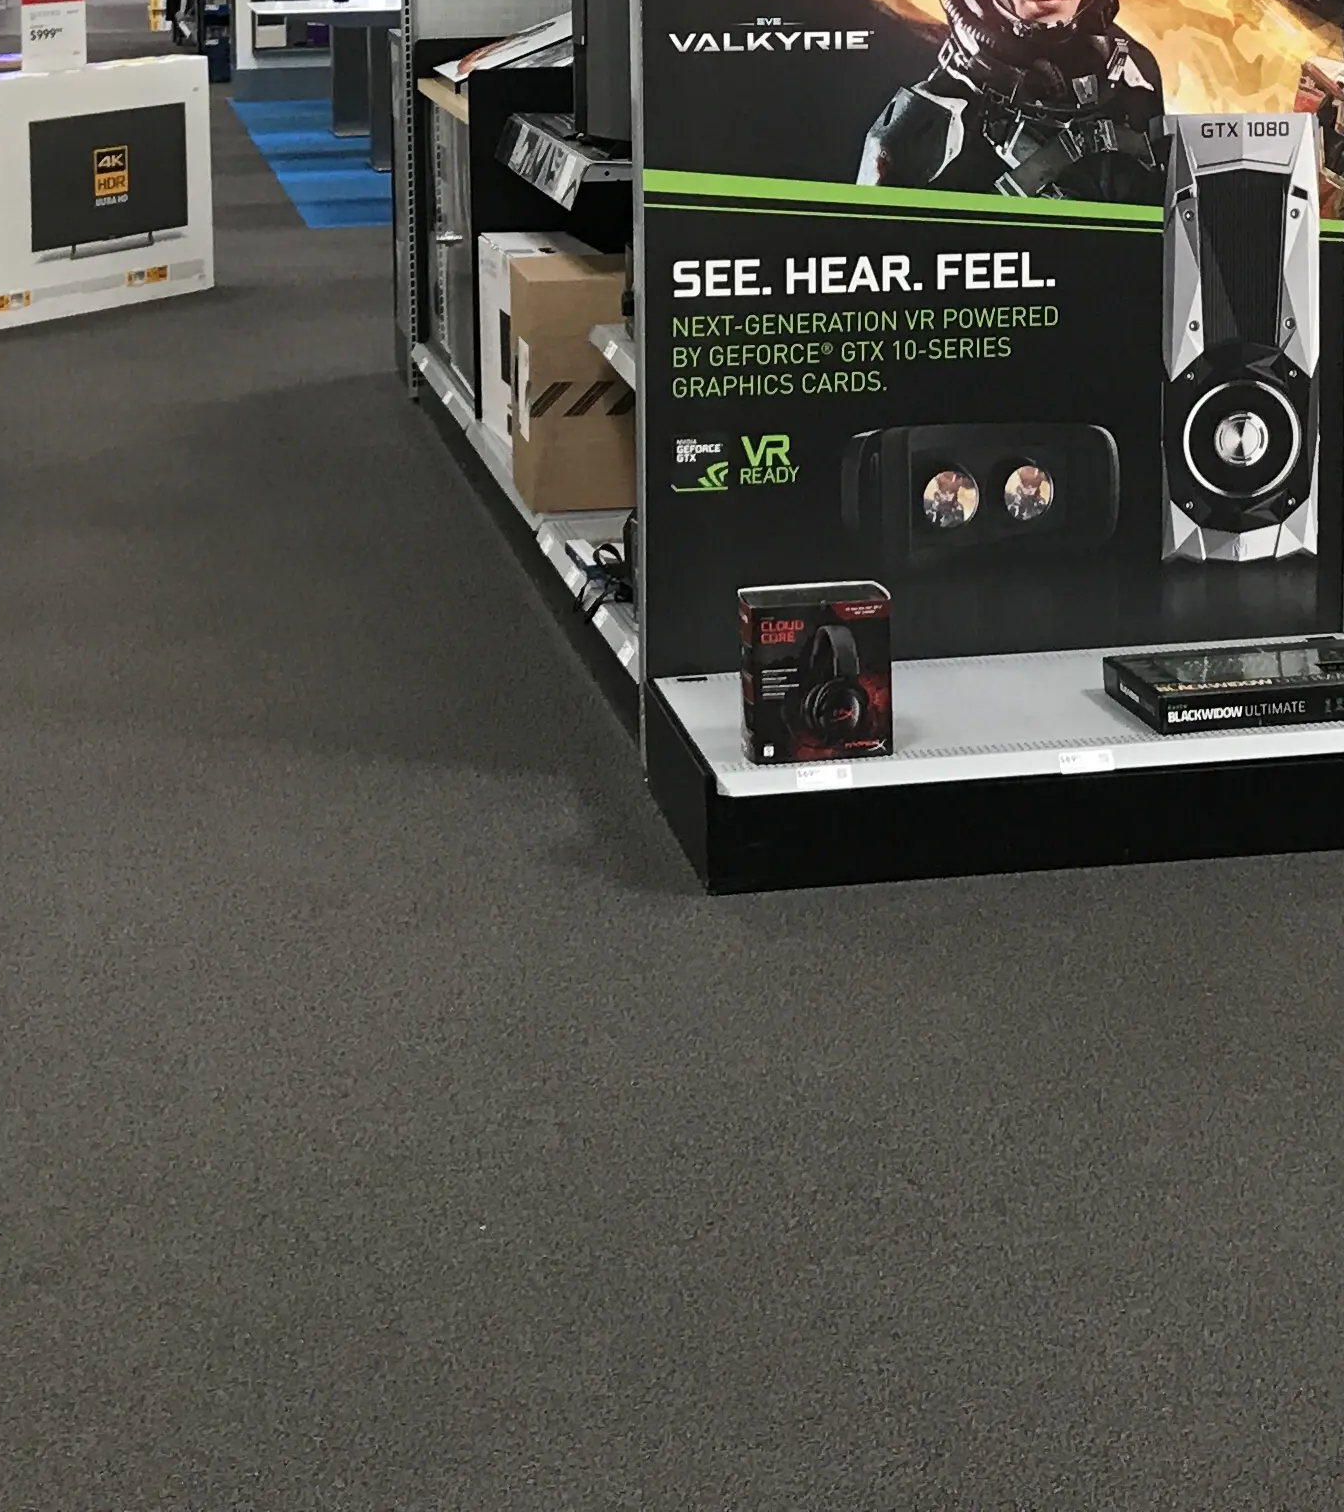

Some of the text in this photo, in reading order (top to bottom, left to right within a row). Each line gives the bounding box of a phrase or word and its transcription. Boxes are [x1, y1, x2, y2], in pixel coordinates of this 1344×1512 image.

[756, 17, 781, 26] EVE
[668, 29, 870, 54] VALKYRIE
[1200, 120, 1290, 139] GTX 1080
[97, 153, 124, 168] 4K
[97, 174, 126, 191] HDR
[672, 251, 1056, 299] SEE. HEAR. FEEL.
[672, 305, 1059, 338] NEXT-GENERATION VR POWERED
[672, 347, 702, 369] BY
[841, 340, 884, 363] GTX
[892, 336, 1011, 361] 10-SERIES
[672, 371, 887, 399] GRAPHICS CARDS.
[676, 443, 724, 455] GEFORCE
[676, 454, 697, 463] GTX
[741, 434, 791, 467] VR
[740, 466, 800, 486] READY
[760, 619, 804, 633] CLOUD
[1167, 700, 1306, 723] BLACKWIDOW ULTIMATE
